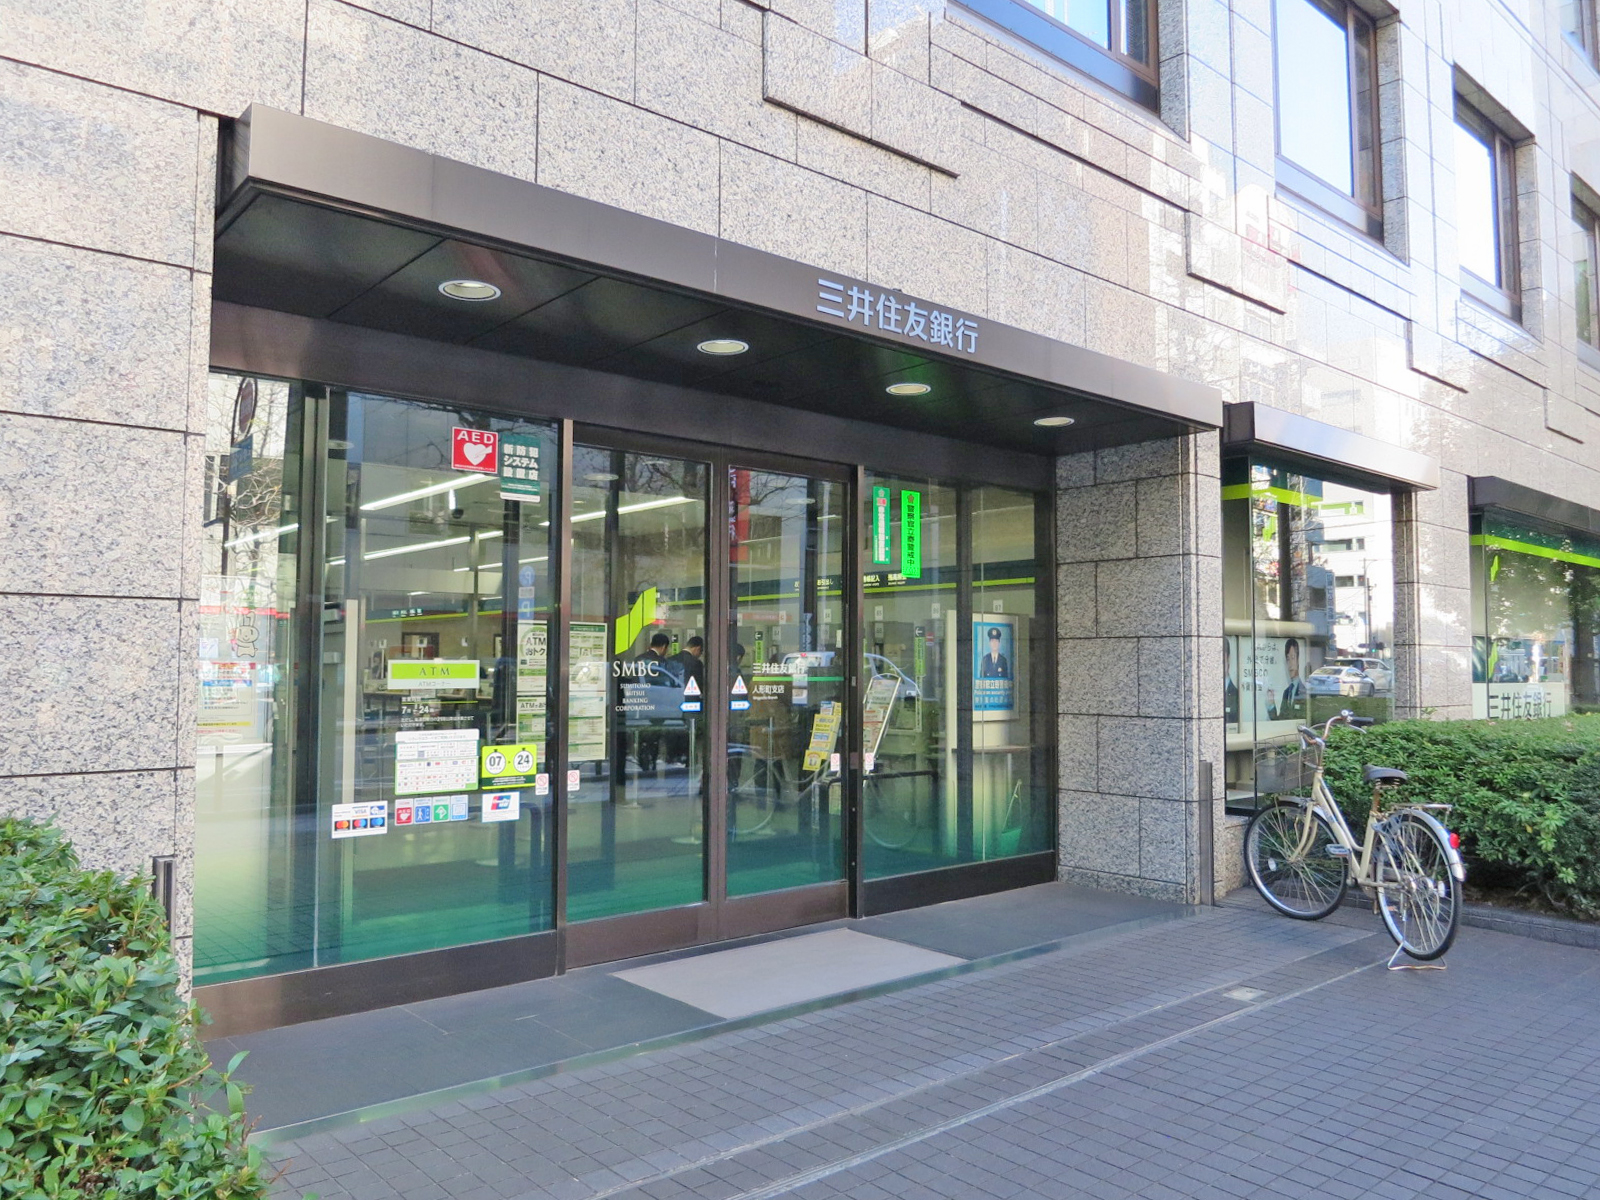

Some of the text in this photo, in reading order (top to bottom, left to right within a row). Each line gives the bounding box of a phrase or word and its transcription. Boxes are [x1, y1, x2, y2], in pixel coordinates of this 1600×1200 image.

[816, 278, 979, 354] 三井住友銀行
[457, 430, 495, 444] AED
[503, 443, 539, 458] 新防犯
[503, 455, 539, 469] システム
[503, 466, 539, 480] 設置店
[526, 637, 546, 646] ATM
[419, 666, 451, 676] ATM
[612, 660, 660, 678] SMBC
[752, 662, 806, 675] 三井住友銀行
[752, 684, 785, 695] 人形町支店
[615, 704, 656, 712] CORPORATION
[1489, 691, 1552, 720] 三井住友銀行
[489, 755, 502, 767] 07
[517, 754, 530, 765] 24
